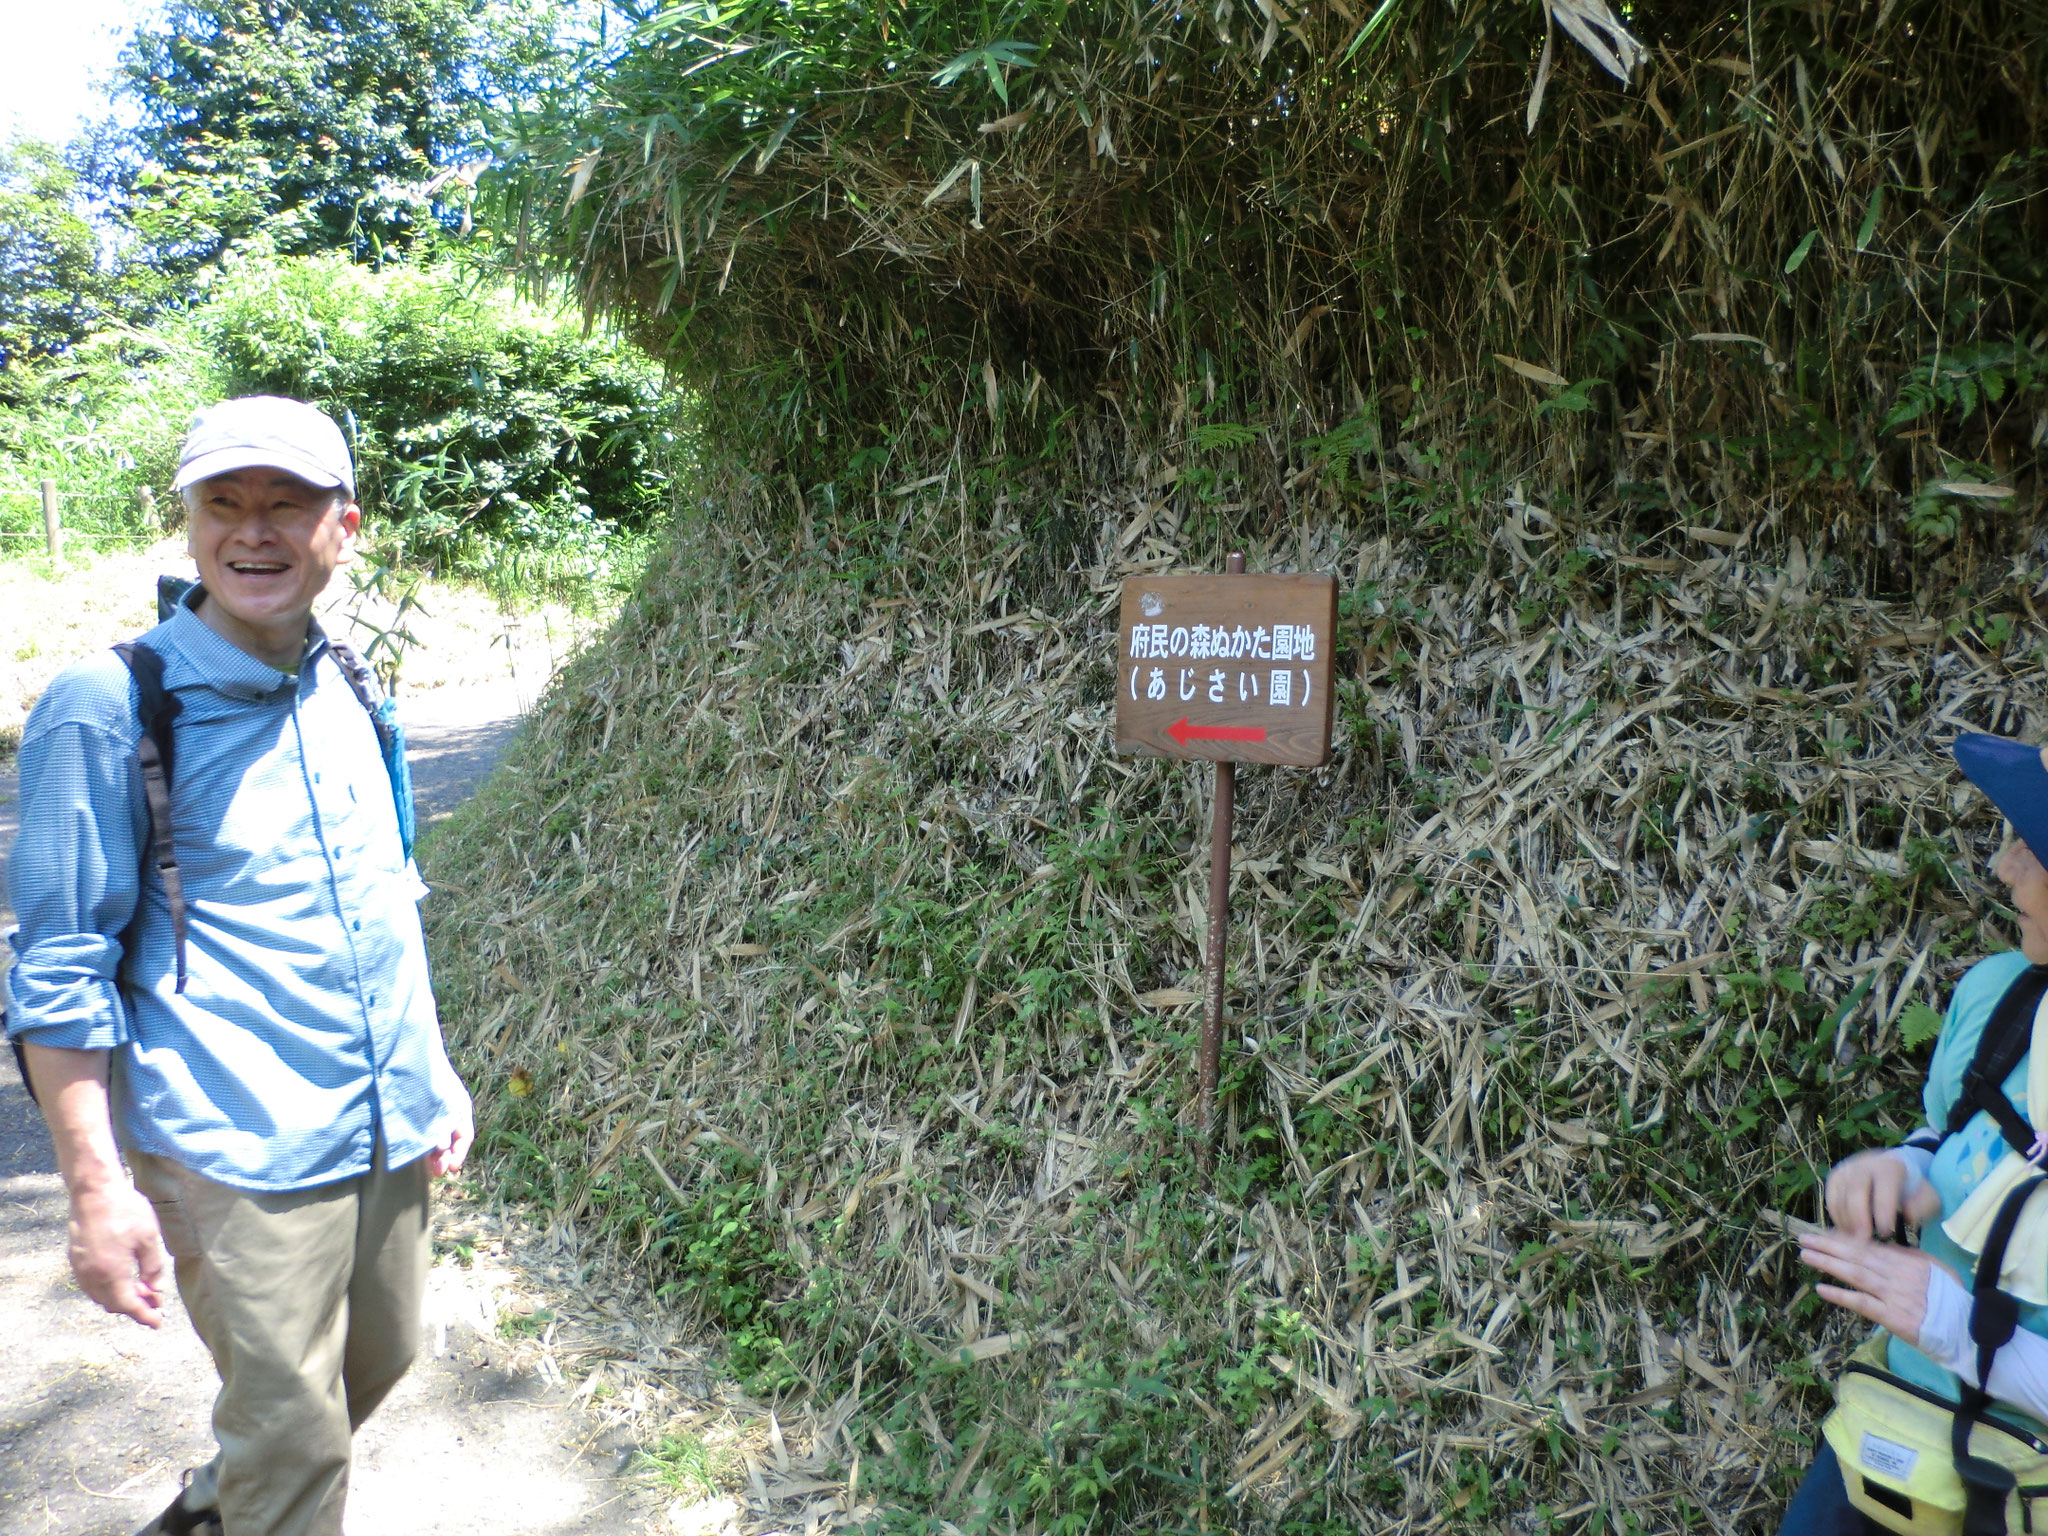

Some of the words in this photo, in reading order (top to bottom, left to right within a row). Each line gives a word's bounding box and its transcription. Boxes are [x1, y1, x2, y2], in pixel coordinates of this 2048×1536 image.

[1130, 623, 1315, 661] 府民の森ぬかた園地
